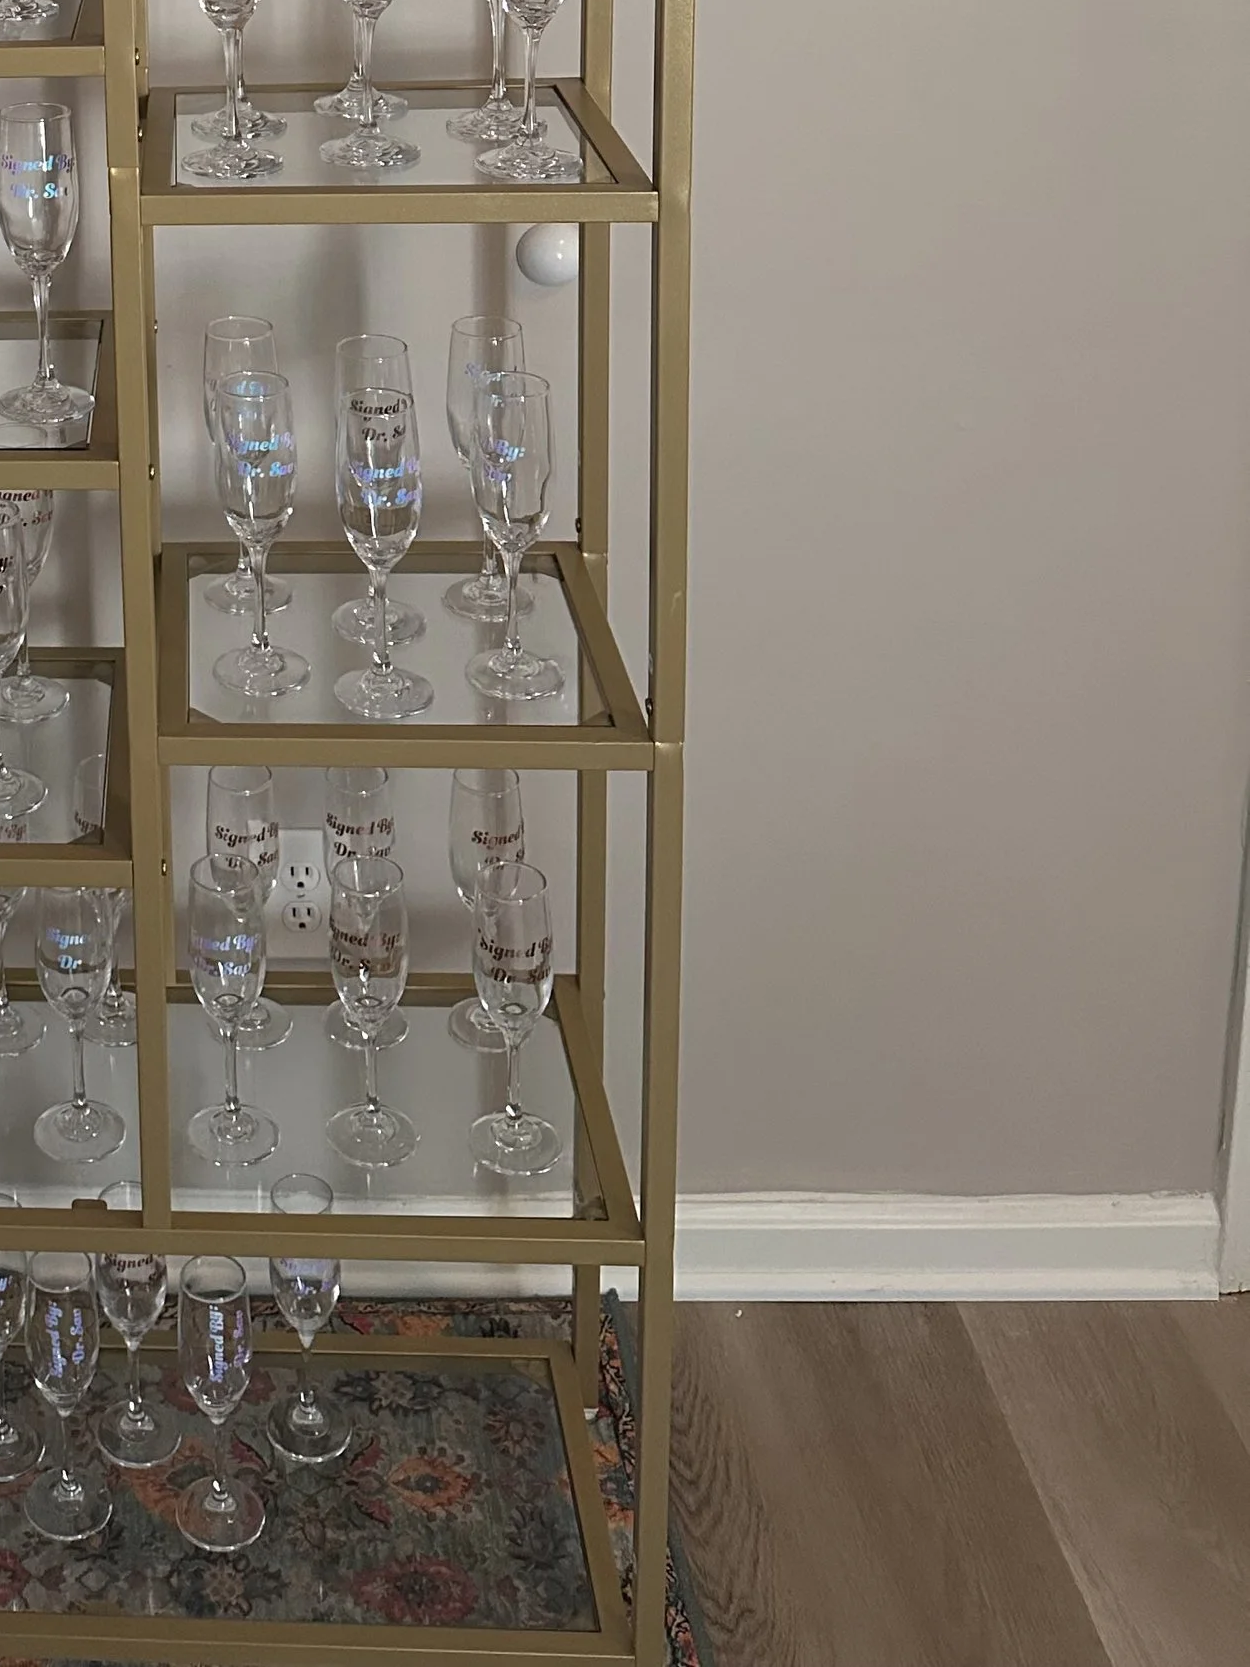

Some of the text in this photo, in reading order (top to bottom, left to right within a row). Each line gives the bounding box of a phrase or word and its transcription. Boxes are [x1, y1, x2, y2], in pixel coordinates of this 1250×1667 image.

[1, 153, 54, 176] Signed
[362, 427, 388, 442] Dr.
[209, 1333, 229, 1383] Signed
